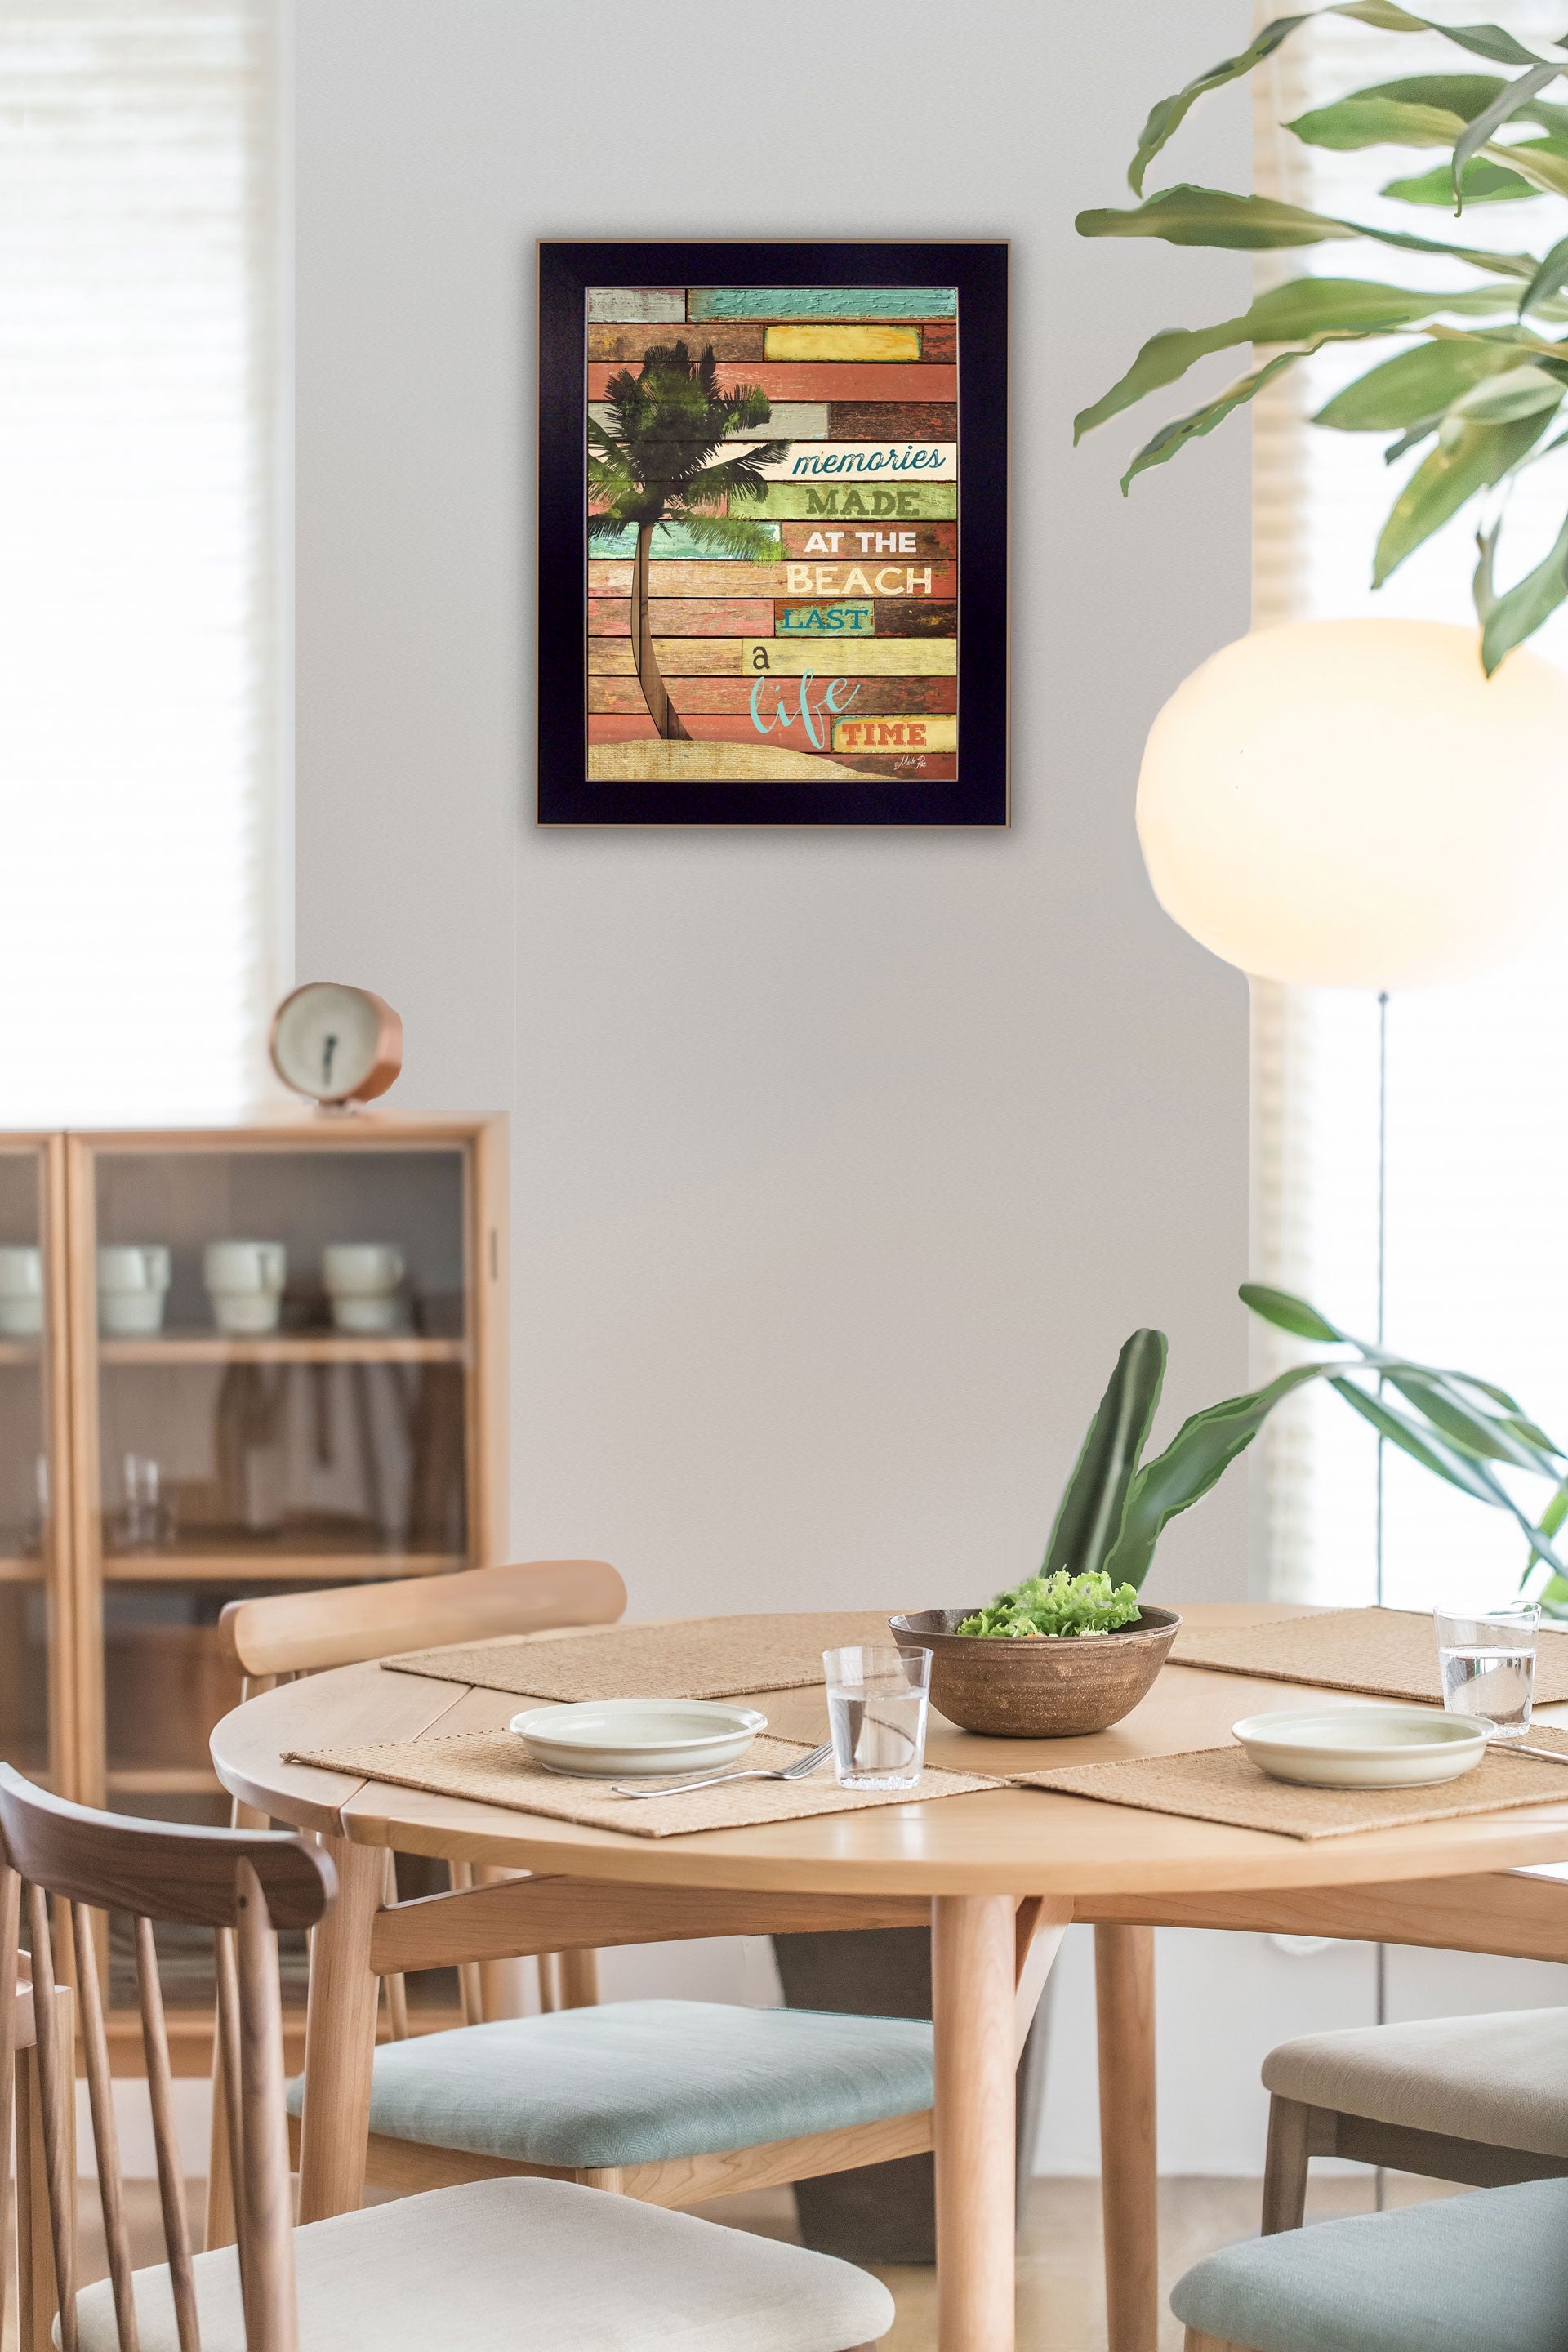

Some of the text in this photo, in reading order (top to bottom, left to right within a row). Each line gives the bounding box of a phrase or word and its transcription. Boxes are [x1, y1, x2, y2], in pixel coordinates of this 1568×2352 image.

[792, 445, 946, 474] memories
[805, 488, 920, 516] MADE
[804, 532, 917, 553] AT THE
[786, 564, 932, 595] BEACH
[781, 608, 869, 630] LAST
[752, 646, 770, 670] a
[750, 668, 861, 750] life
[842, 723, 927, 747] TIME
